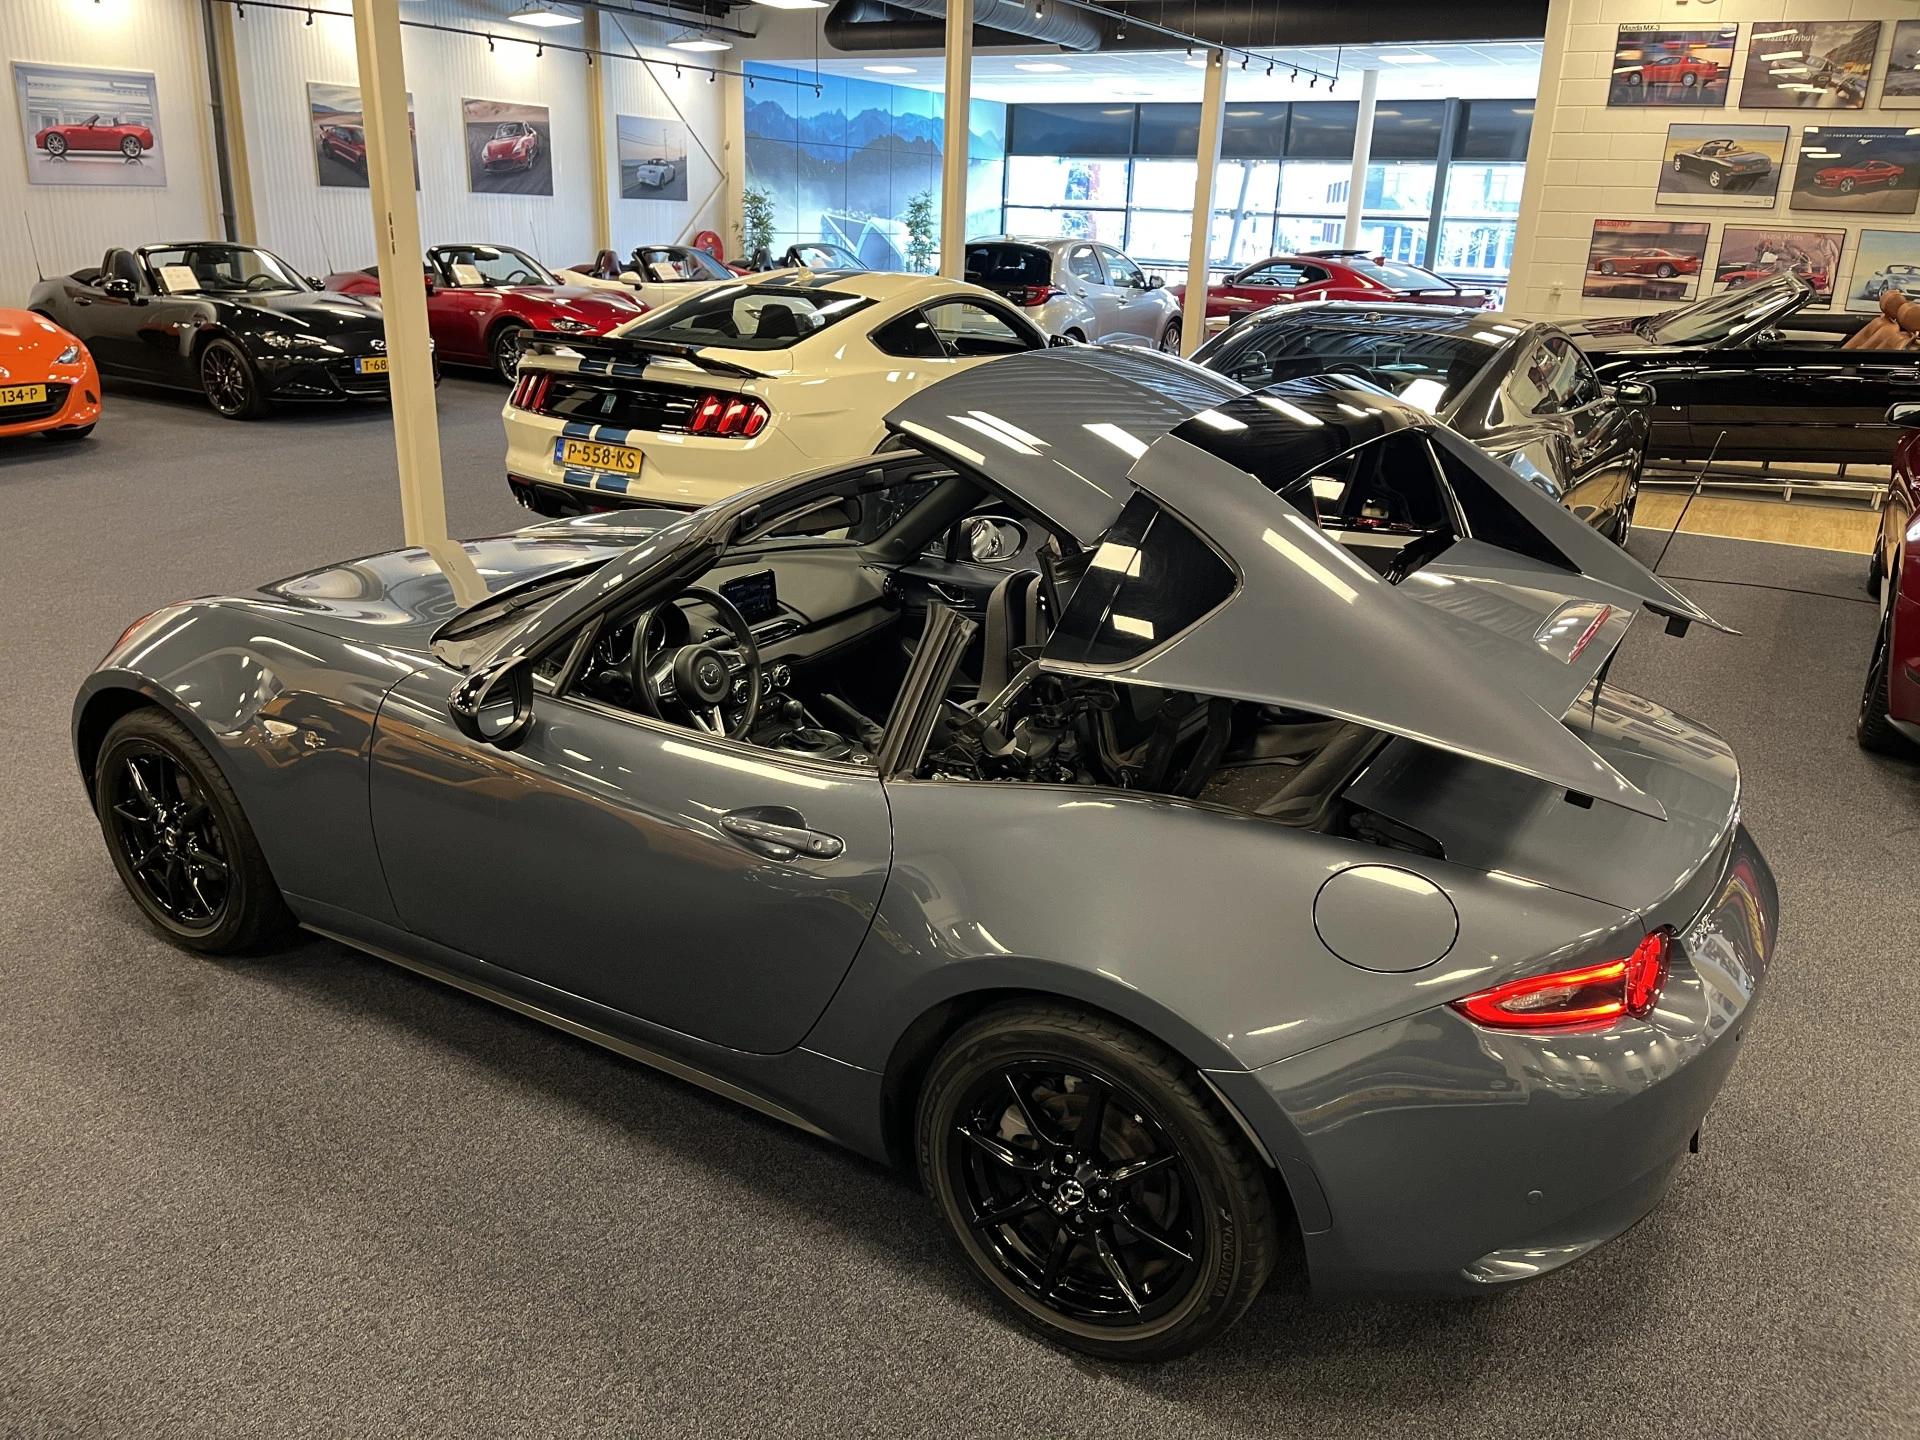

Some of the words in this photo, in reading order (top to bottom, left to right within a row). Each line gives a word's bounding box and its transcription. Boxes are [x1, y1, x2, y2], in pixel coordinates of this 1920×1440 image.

[1790, 34, 1818, 42] Tribute
[364, 359, 390, 371] T-68
[1, 388, 38, 403] 134-P
[567, 443, 636, 469] P-558-KS
[1213, 1224, 1234, 1297] YOKOHAMA
